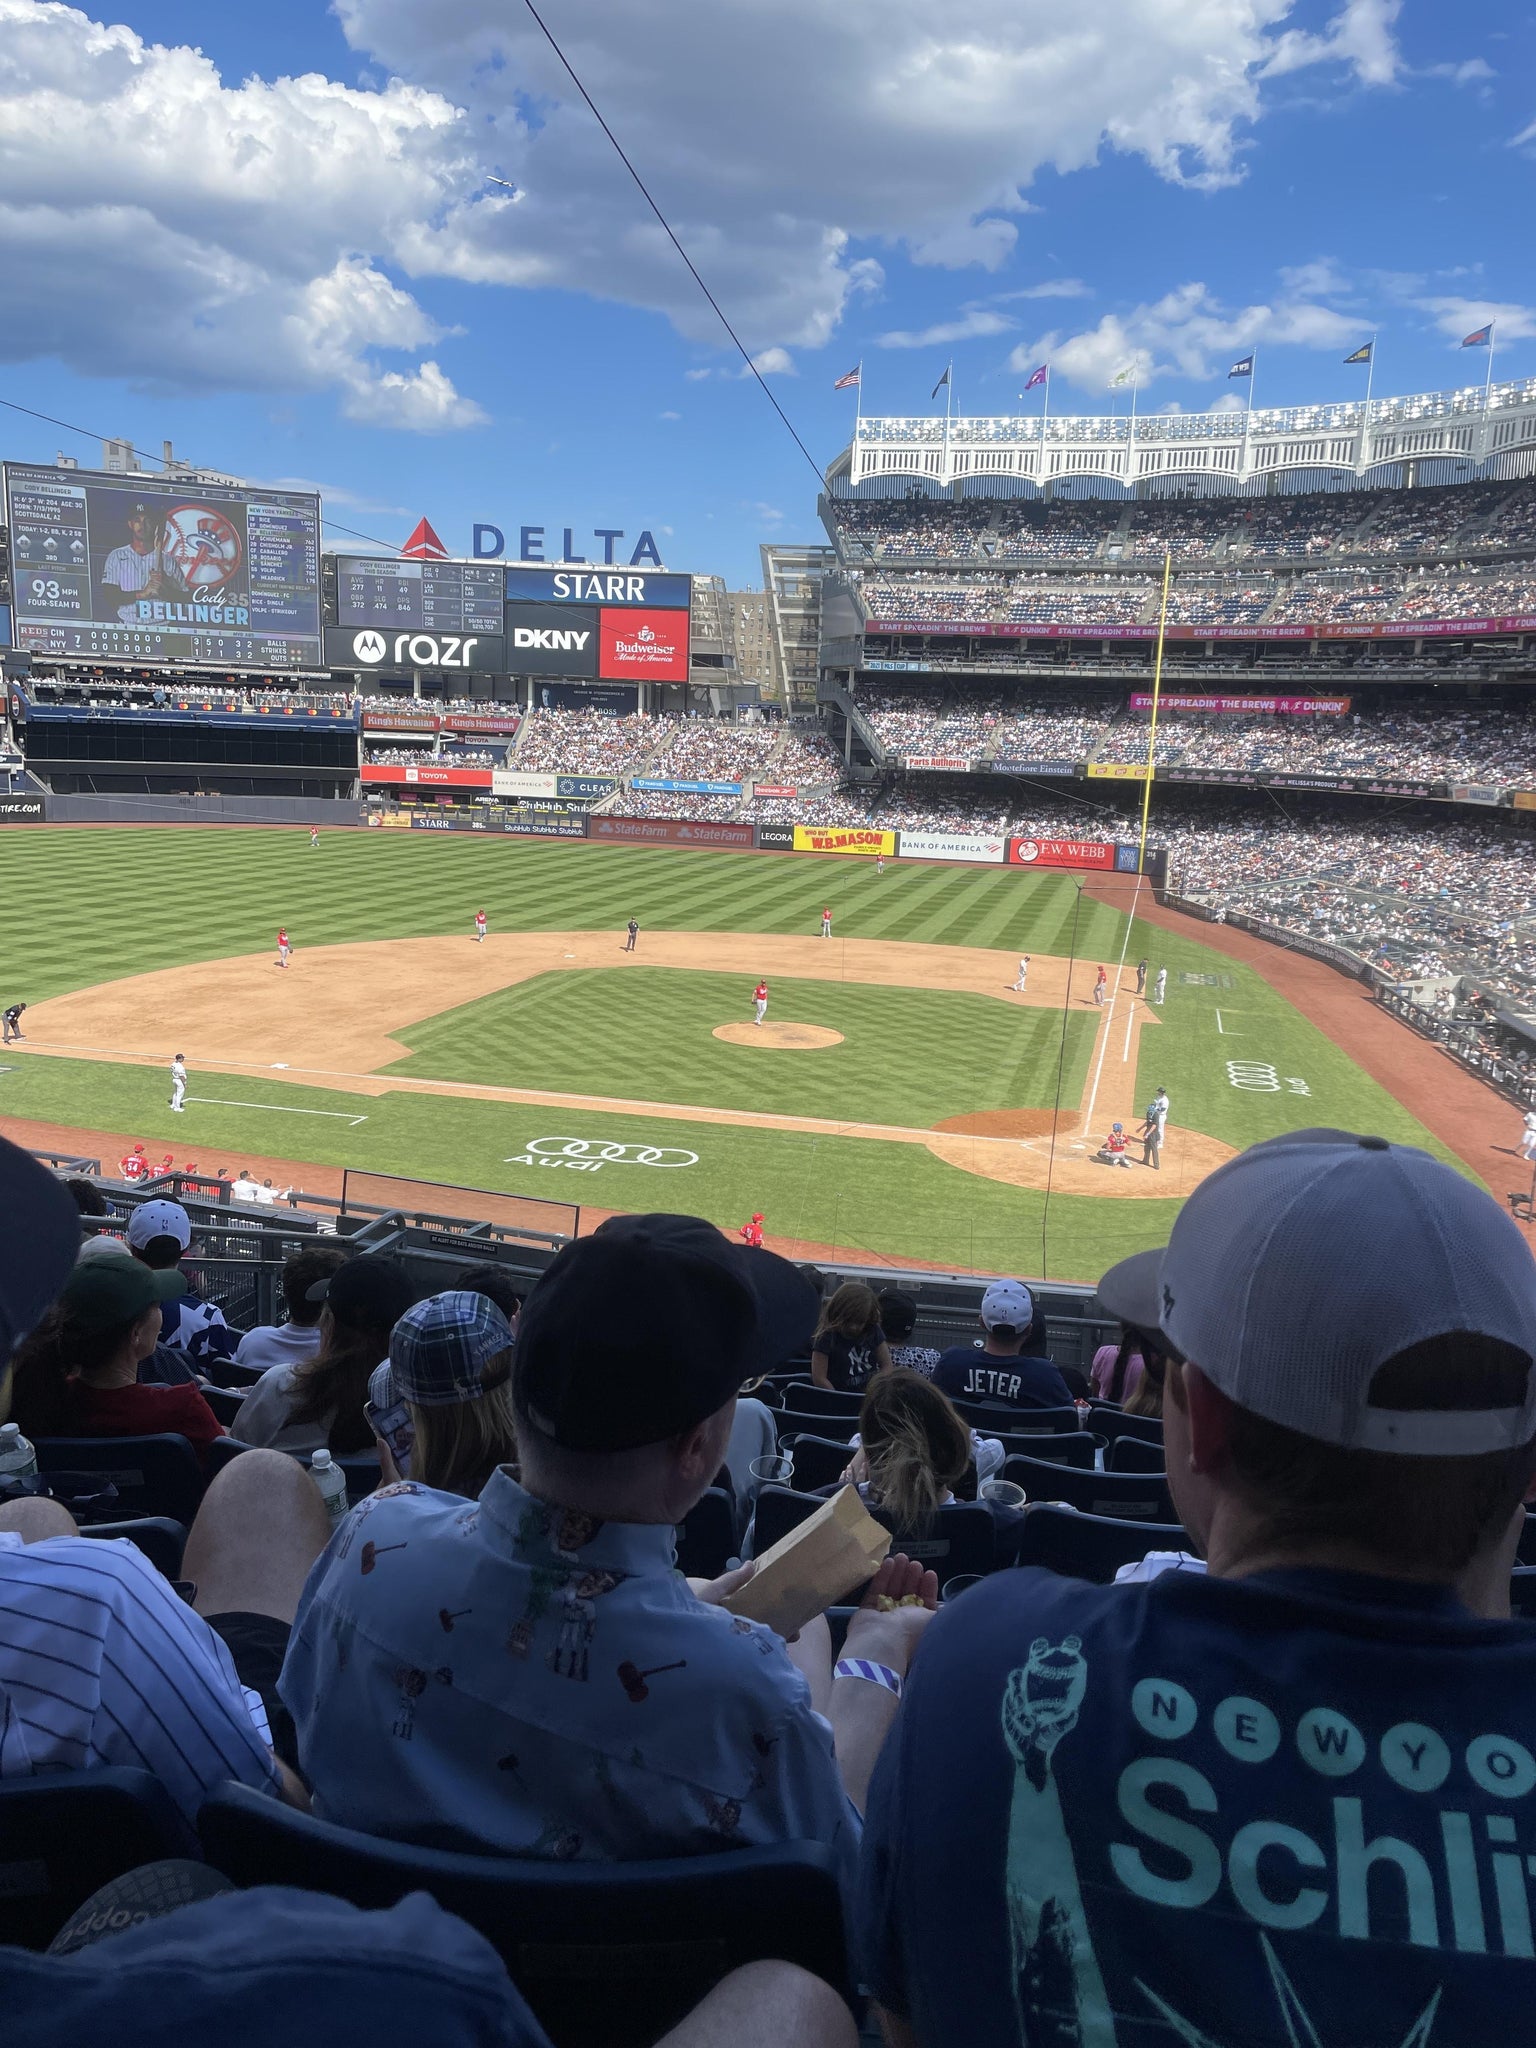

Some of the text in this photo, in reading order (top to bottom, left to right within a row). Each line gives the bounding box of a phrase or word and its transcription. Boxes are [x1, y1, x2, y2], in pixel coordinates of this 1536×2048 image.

[473, 523, 662, 567] DELTA
[350, 576, 364, 584] AVG
[32, 579, 78, 599] 93 MPH
[553, 573, 645, 601] STARR
[28, 598, 80, 609] FOUR-SEAM FB
[192, 585, 249, 611] Cody 35
[350, 601, 365, 609] .372
[138, 600, 249, 625] BELLINGER
[20, 626, 48, 635] REDS
[879, 623, 902, 631] START
[903, 624, 942, 632] SPREADIN'
[1057, 627, 1082, 635] START
[1083, 627, 1123, 636] SPREADIN'
[1125, 628, 1141, 636] THE
[1193, 627, 1306, 636] START SPREADIN' THE BREWS
[1343, 626, 1376, 635] DUNKIN'
[1381, 621, 1488, 634] START SPREADIN' THE BREWS
[50, 629, 65, 637] CIN
[91, 631, 97, 639] 0
[102, 631, 108, 640] 0
[113, 632, 119, 640] 0
[123, 633, 130, 641] 3
[145, 634, 151, 642] 0
[155, 635, 161, 643] 0
[74, 635, 81, 644] 7
[514, 627, 590, 651] DKNY
[50, 640, 66, 649] NYY
[102, 643, 109, 651] 0
[114, 644, 118, 652] 1
[124, 644, 130, 652] 0
[145, 645, 151, 653] 0
[267, 640, 287, 648] BALLS
[615, 640, 676, 655] Budweiser
[260, 647, 288, 655] STRIKES
[394, 634, 478, 667] razr
[270, 654, 287, 662] OUTS
[614, 652, 637, 661] Made
[643, 654, 673, 663] America
[1167, 699, 1219, 708] SPREADIN'
[1221, 700, 1240, 708] THE
[1241, 700, 1276, 709] BREWS
[1303, 701, 1344, 711] DUNKIN'
[367, 716, 435, 728] King's Hawaiian
[451, 718, 515, 729] King's Hawaiian
[909, 757, 967, 768] Parts Authority
[1039, 764, 1073, 774] Einstein
[420, 772, 449, 780] TOYOTA
[579, 783, 612, 792] CLEAR
[1287, 779, 1314, 788] MELISSA'S
[1314, 781, 1338, 789] PRODUCE
[755, 786, 781, 794] Reebok
[0, 803, 41, 814] TIRE.COM
[419, 818, 450, 829] STARR
[471, 821, 484, 829] 385
[504, 824, 584, 836] StubHub StubHub StubHub
[615, 822, 668, 837] State Farm
[693, 828, 747, 842] State Farm
[760, 832, 793, 842] LEGORA
[901, 841, 982, 852] BANK OF AMERICA
[1040, 842, 1064, 856] F.W.
[1067, 844, 1106, 859] WEBB
[1284, 1076, 1313, 1097] Audi
[127, 1163, 139, 1172] 54
[503, 1154, 605, 1172] Audi
[963, 1368, 1022, 1400] JETER
[1109, 1756, 1536, 1959] Schli
